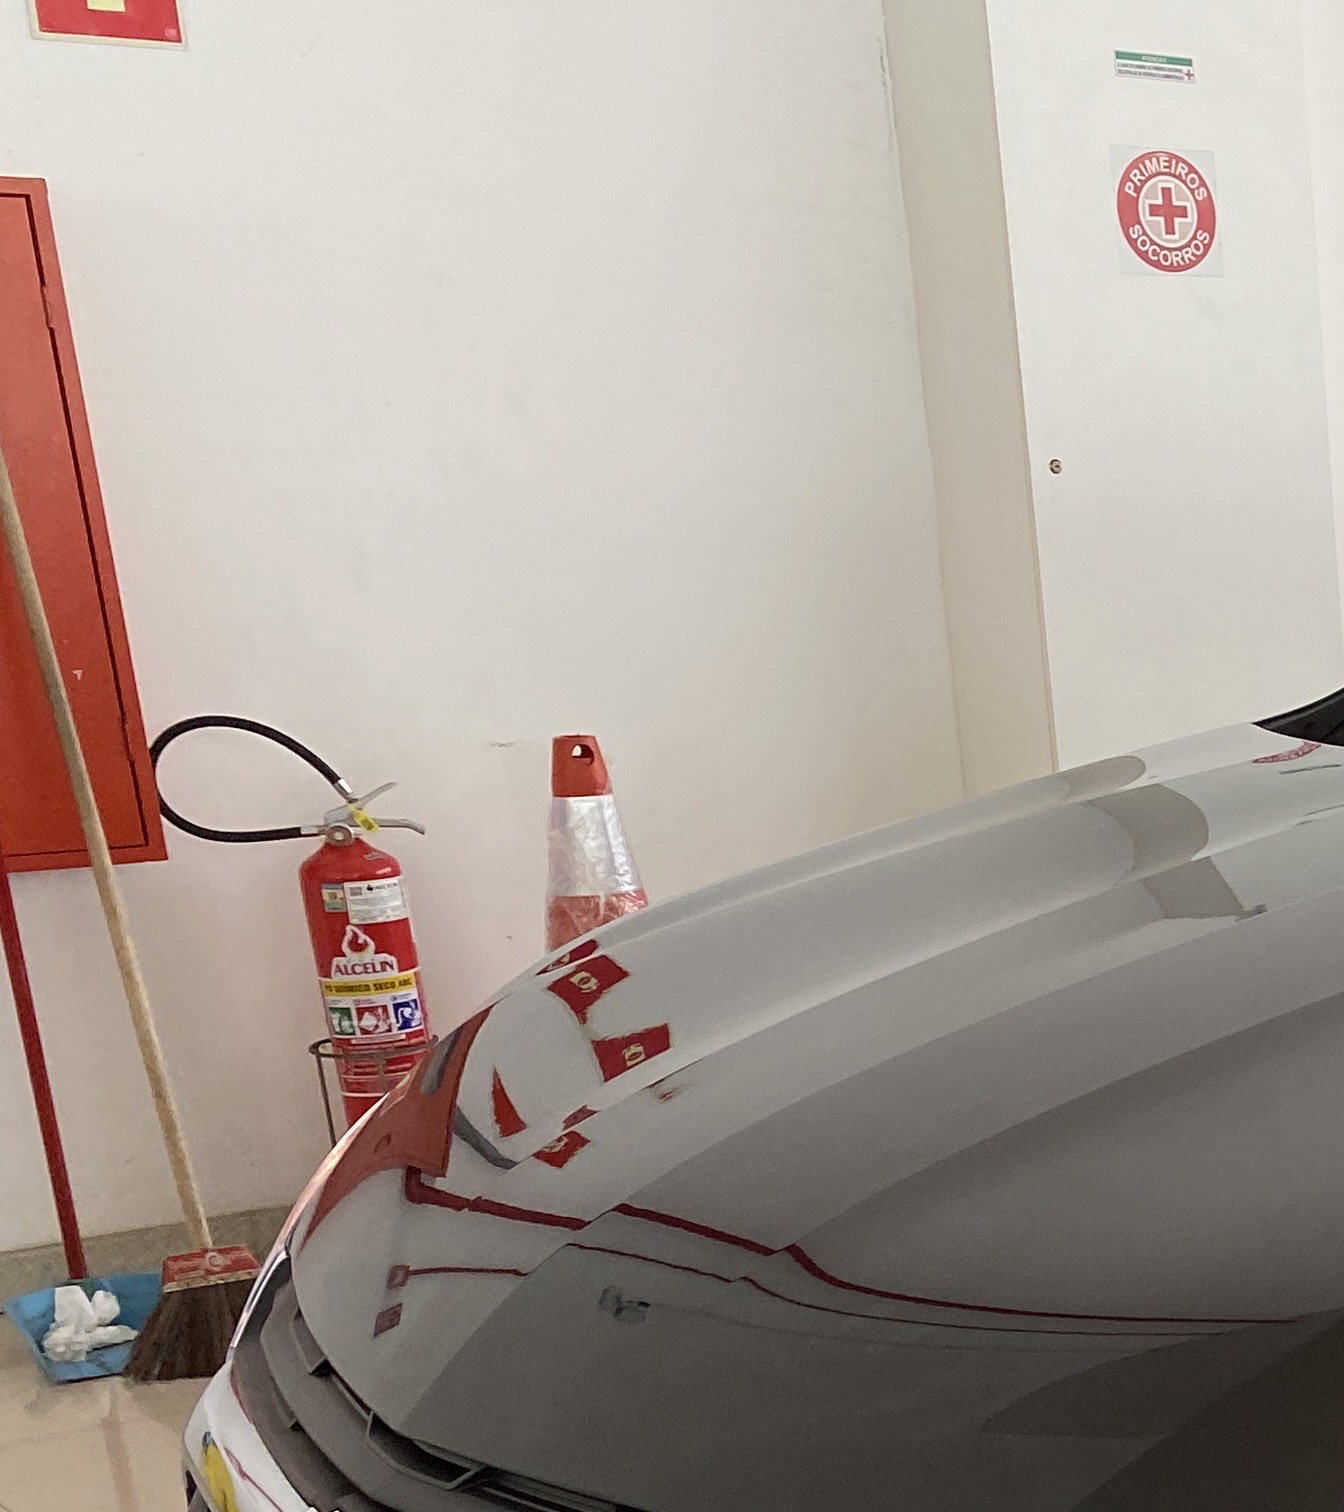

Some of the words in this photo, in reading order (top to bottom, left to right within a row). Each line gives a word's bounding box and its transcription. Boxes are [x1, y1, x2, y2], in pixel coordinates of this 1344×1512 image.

[1124, 156, 1208, 202] PRIMEIROS
[1129, 223, 1210, 268] SOCORROS
[334, 961, 395, 976] ALCELIN
[373, 981, 396, 991] SECO
